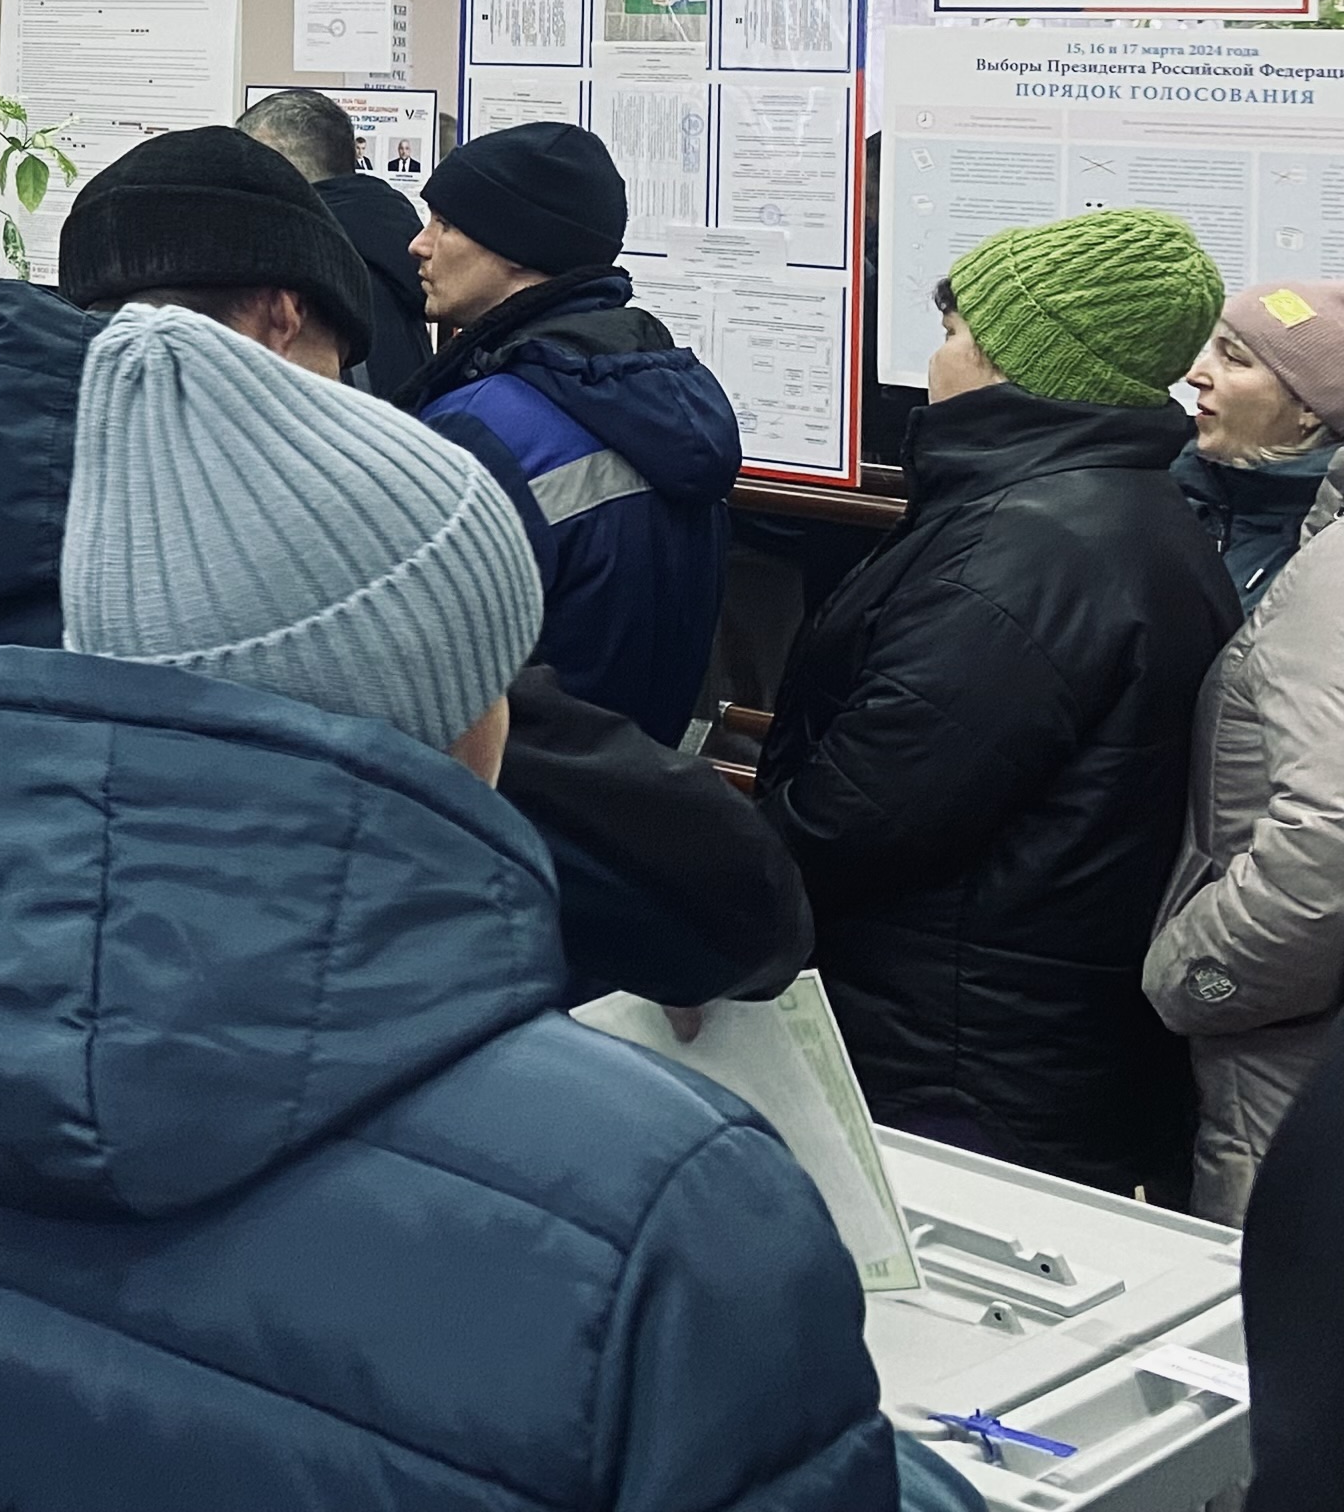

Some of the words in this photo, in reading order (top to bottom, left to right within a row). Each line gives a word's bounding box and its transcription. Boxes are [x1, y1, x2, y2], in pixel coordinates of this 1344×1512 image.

[1066, 43, 1085, 55] 15,
[1090, 43, 1105, 54] 16
[1122, 43, 1138, 54] 17
[1141, 46, 1184, 58] марта
[1189, 45, 1222, 56] 2024
[1226, 47, 1260, 58] года
[976, 58, 1042, 76] Выборы
[1047, 59, 1146, 76] Президента
[1152, 62, 1254, 77] Российской
[1016, 83, 1122, 101] ПОРЯДОК
[1131, 85, 1315, 105] ГОЛОСОВАНИЯ
